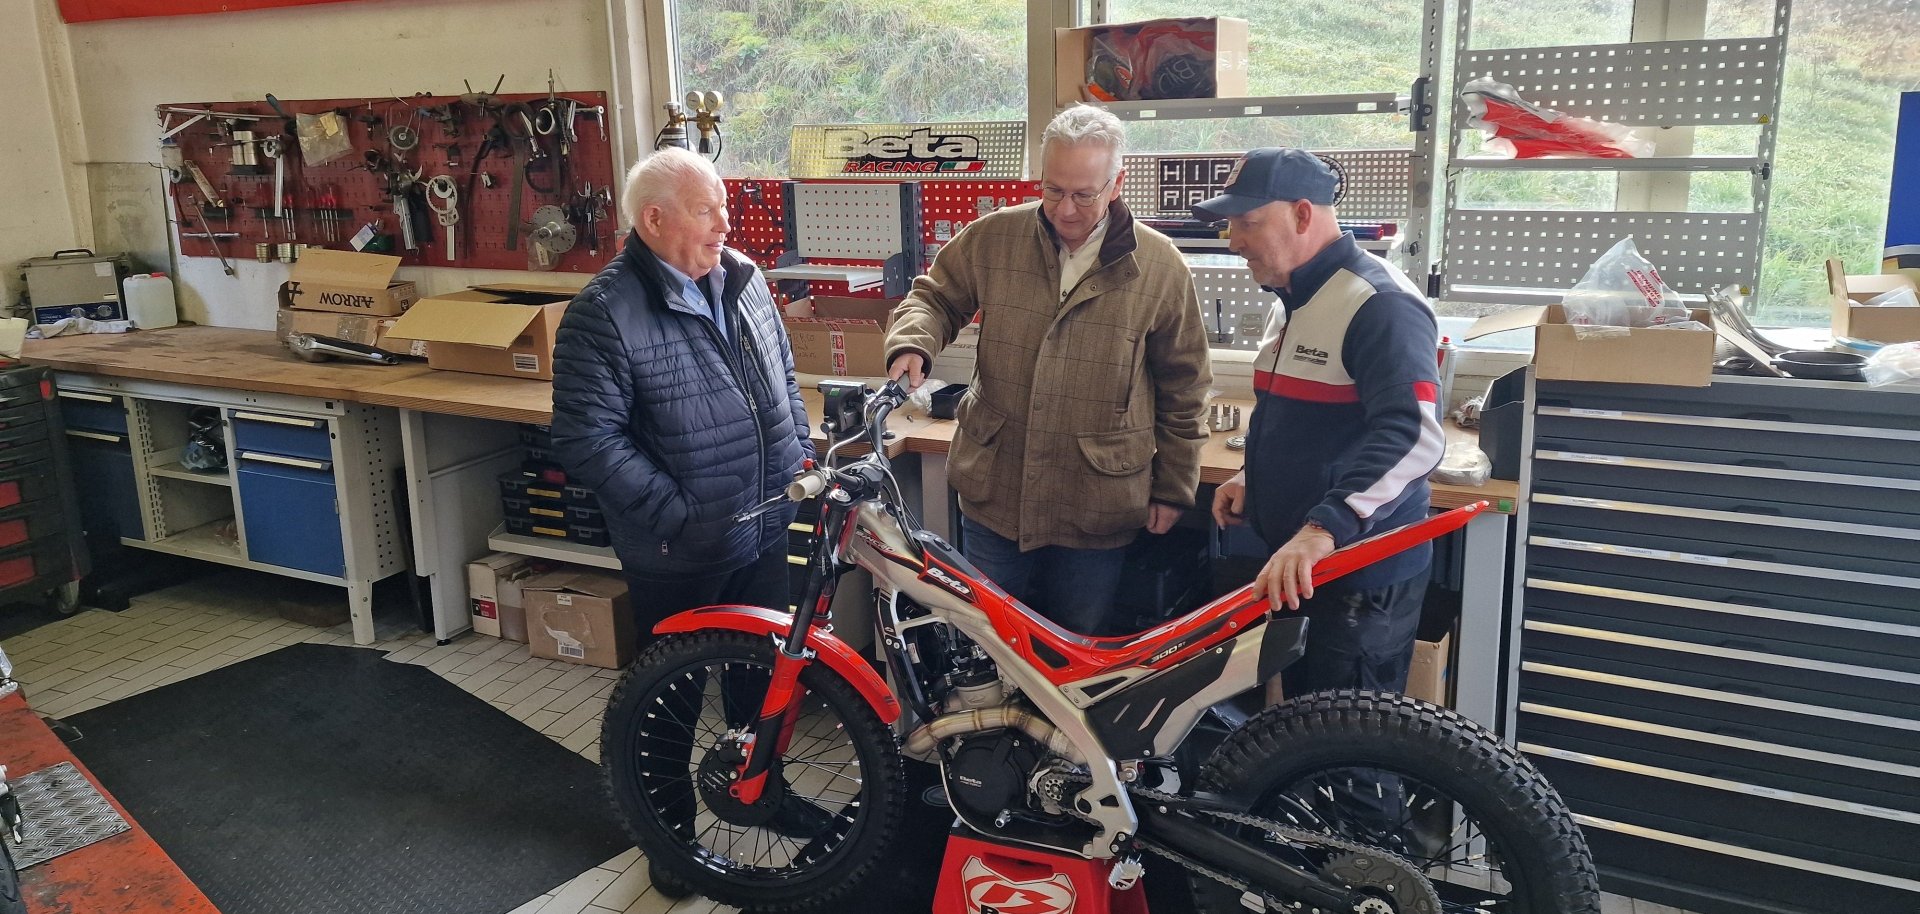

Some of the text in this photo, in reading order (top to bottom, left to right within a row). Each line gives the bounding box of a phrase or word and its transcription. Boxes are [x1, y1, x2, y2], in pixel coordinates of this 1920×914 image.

[823, 127, 980, 160] Beta
[841, 160, 938, 173] RACING
[1163, 163, 1231, 182] HIP
[319, 292, 374, 309] ARROW
[1295, 344, 1329, 358] Beta
[926, 566, 971, 595] Beta
[1151, 645, 1178, 664] 300
